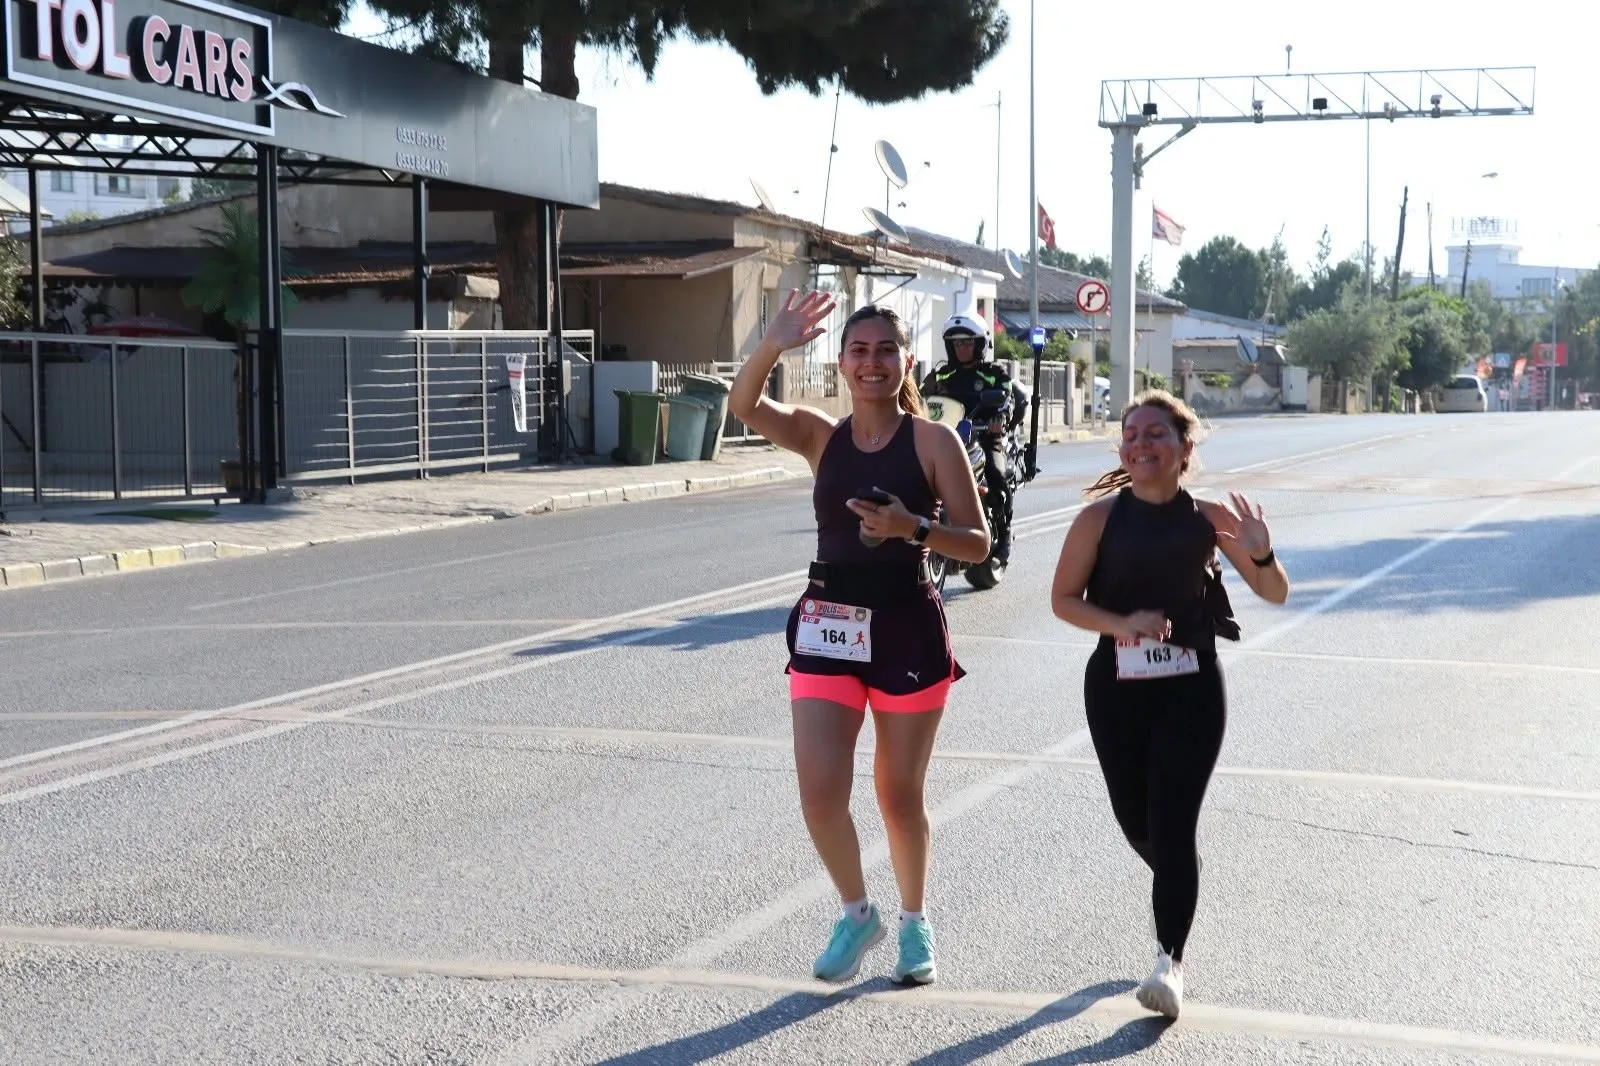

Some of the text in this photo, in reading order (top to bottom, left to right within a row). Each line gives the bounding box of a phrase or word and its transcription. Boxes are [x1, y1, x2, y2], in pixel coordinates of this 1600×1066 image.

[30, 0, 254, 103] TOL CARS
[821, 628, 846, 645] 164
[1144, 646, 1171, 664] 163
